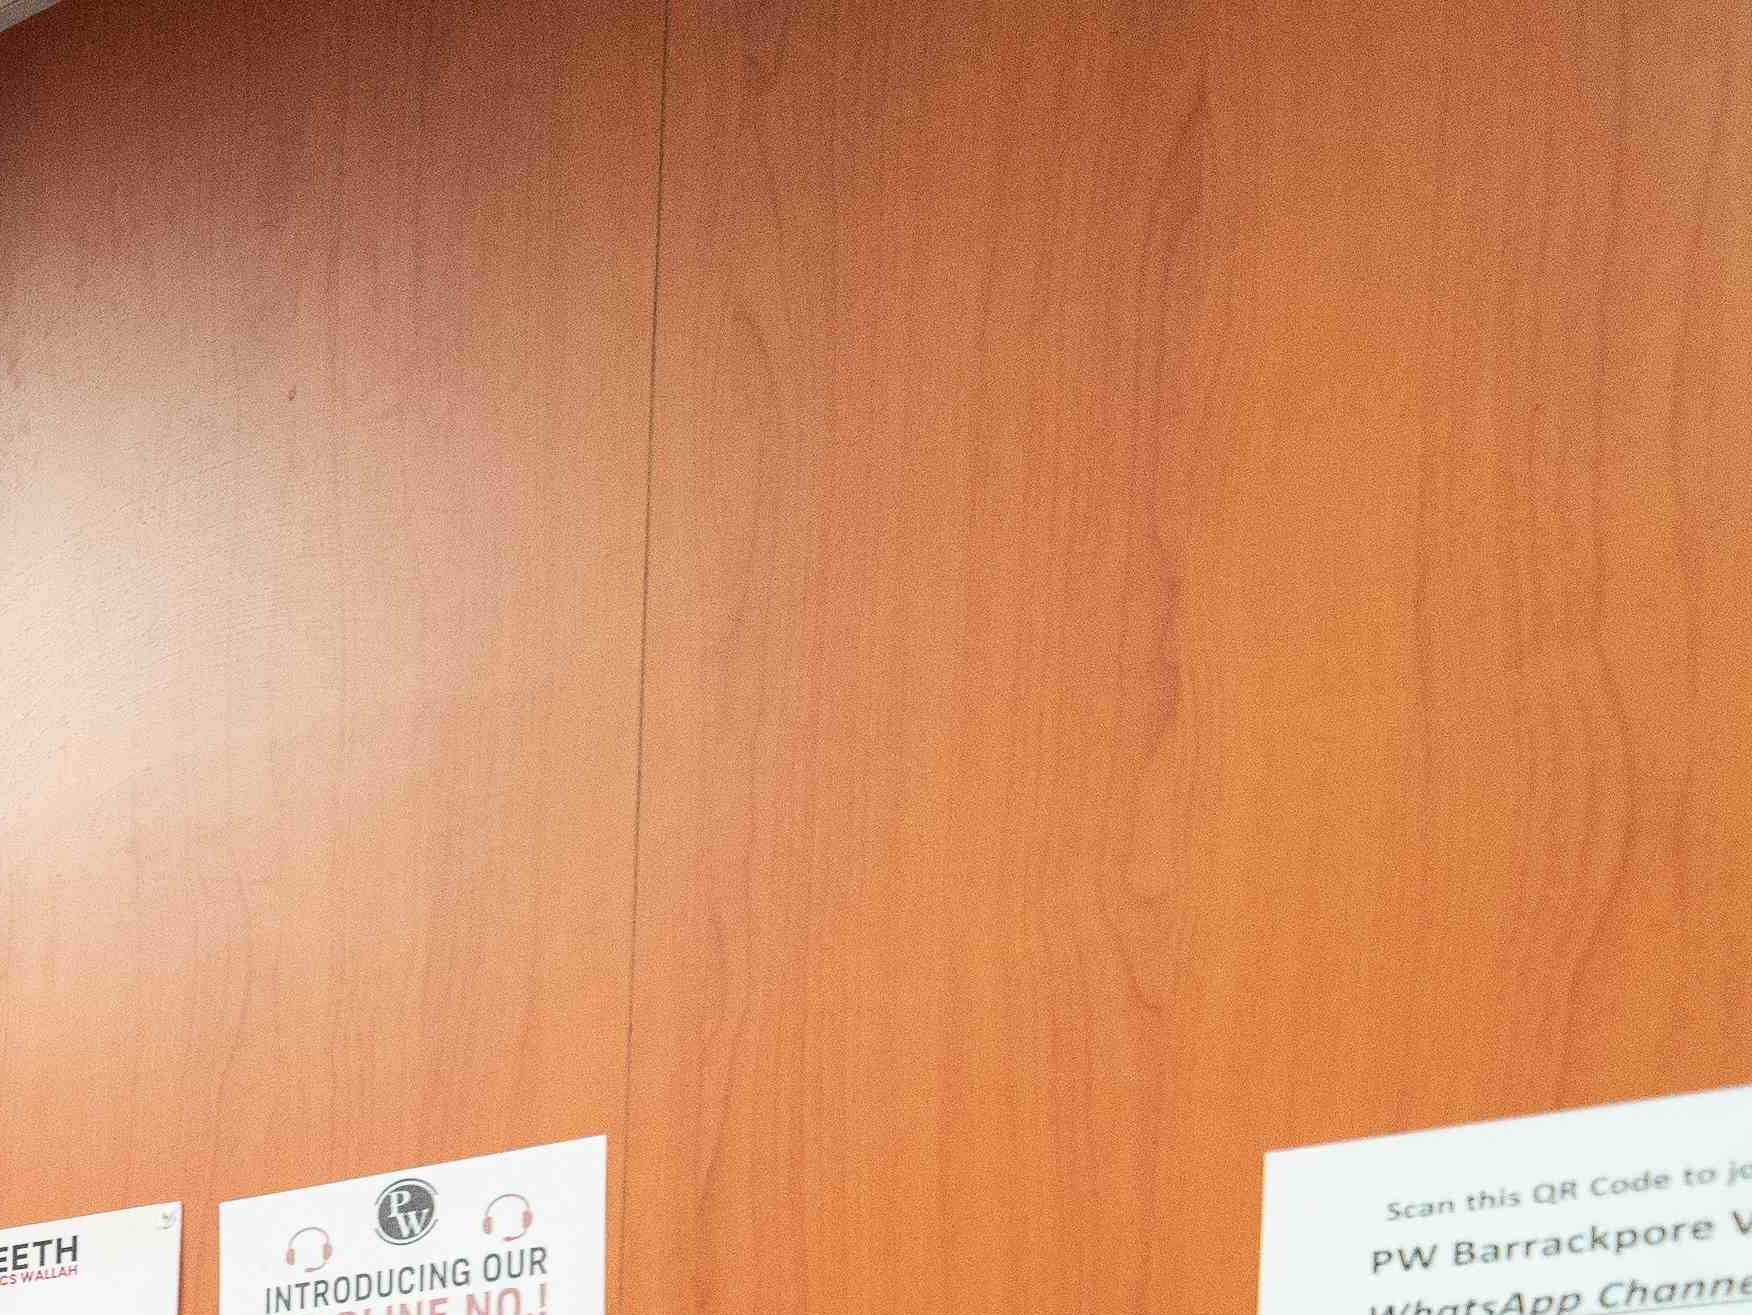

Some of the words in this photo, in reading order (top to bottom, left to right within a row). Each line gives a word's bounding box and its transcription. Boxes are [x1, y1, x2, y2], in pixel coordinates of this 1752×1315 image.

[1387, 1200, 1456, 1222] Scan
[1467, 1191, 1521, 1212] this
[1533, 1181, 1578, 1205] QR
[1591, 1170, 1672, 1198] Code
[1683, 1167, 1717, 1185] to
[20, 1265, 78, 1283] WALLAH
[1372, 1244, 1438, 1276] PW
[1453, 1216, 1716, 1266] Barrackpore
[265, 1257, 470, 1314] INTRODUCING
[483, 1246, 547, 1282] OUR
